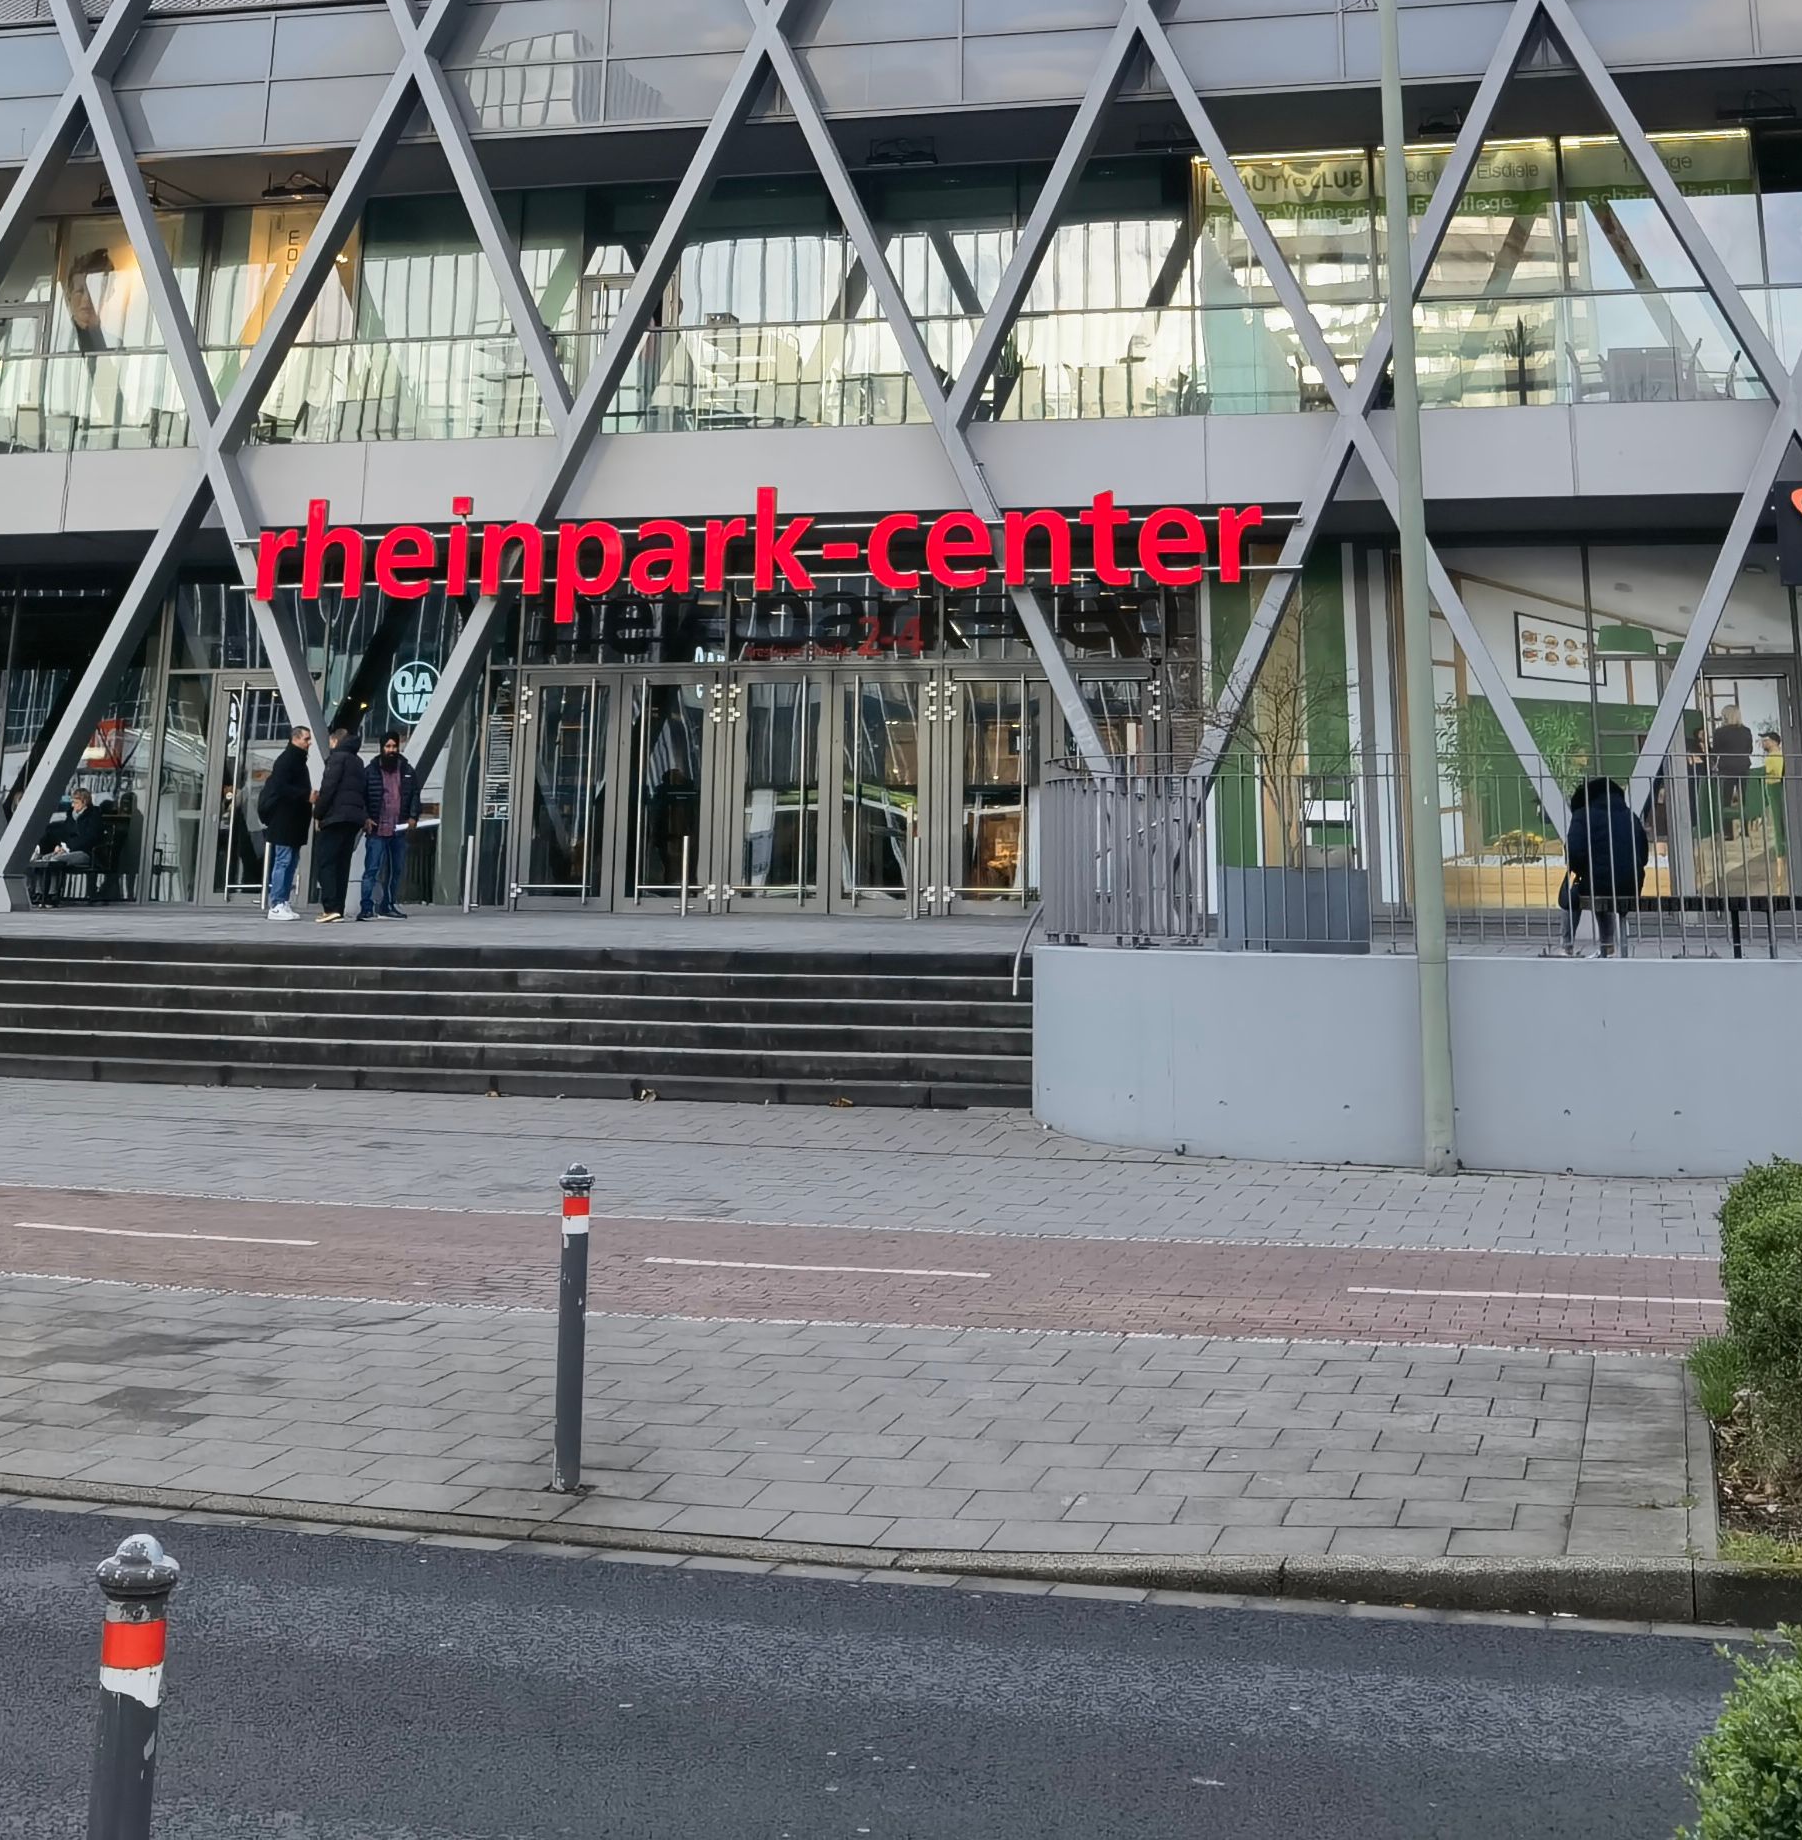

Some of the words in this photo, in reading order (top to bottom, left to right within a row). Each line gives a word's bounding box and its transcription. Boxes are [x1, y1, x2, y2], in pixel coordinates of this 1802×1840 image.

[254, 486, 1263, 624] rheinpark-center
[858, 615, 925, 657] 2-4
[393, 670, 433, 693] QA
